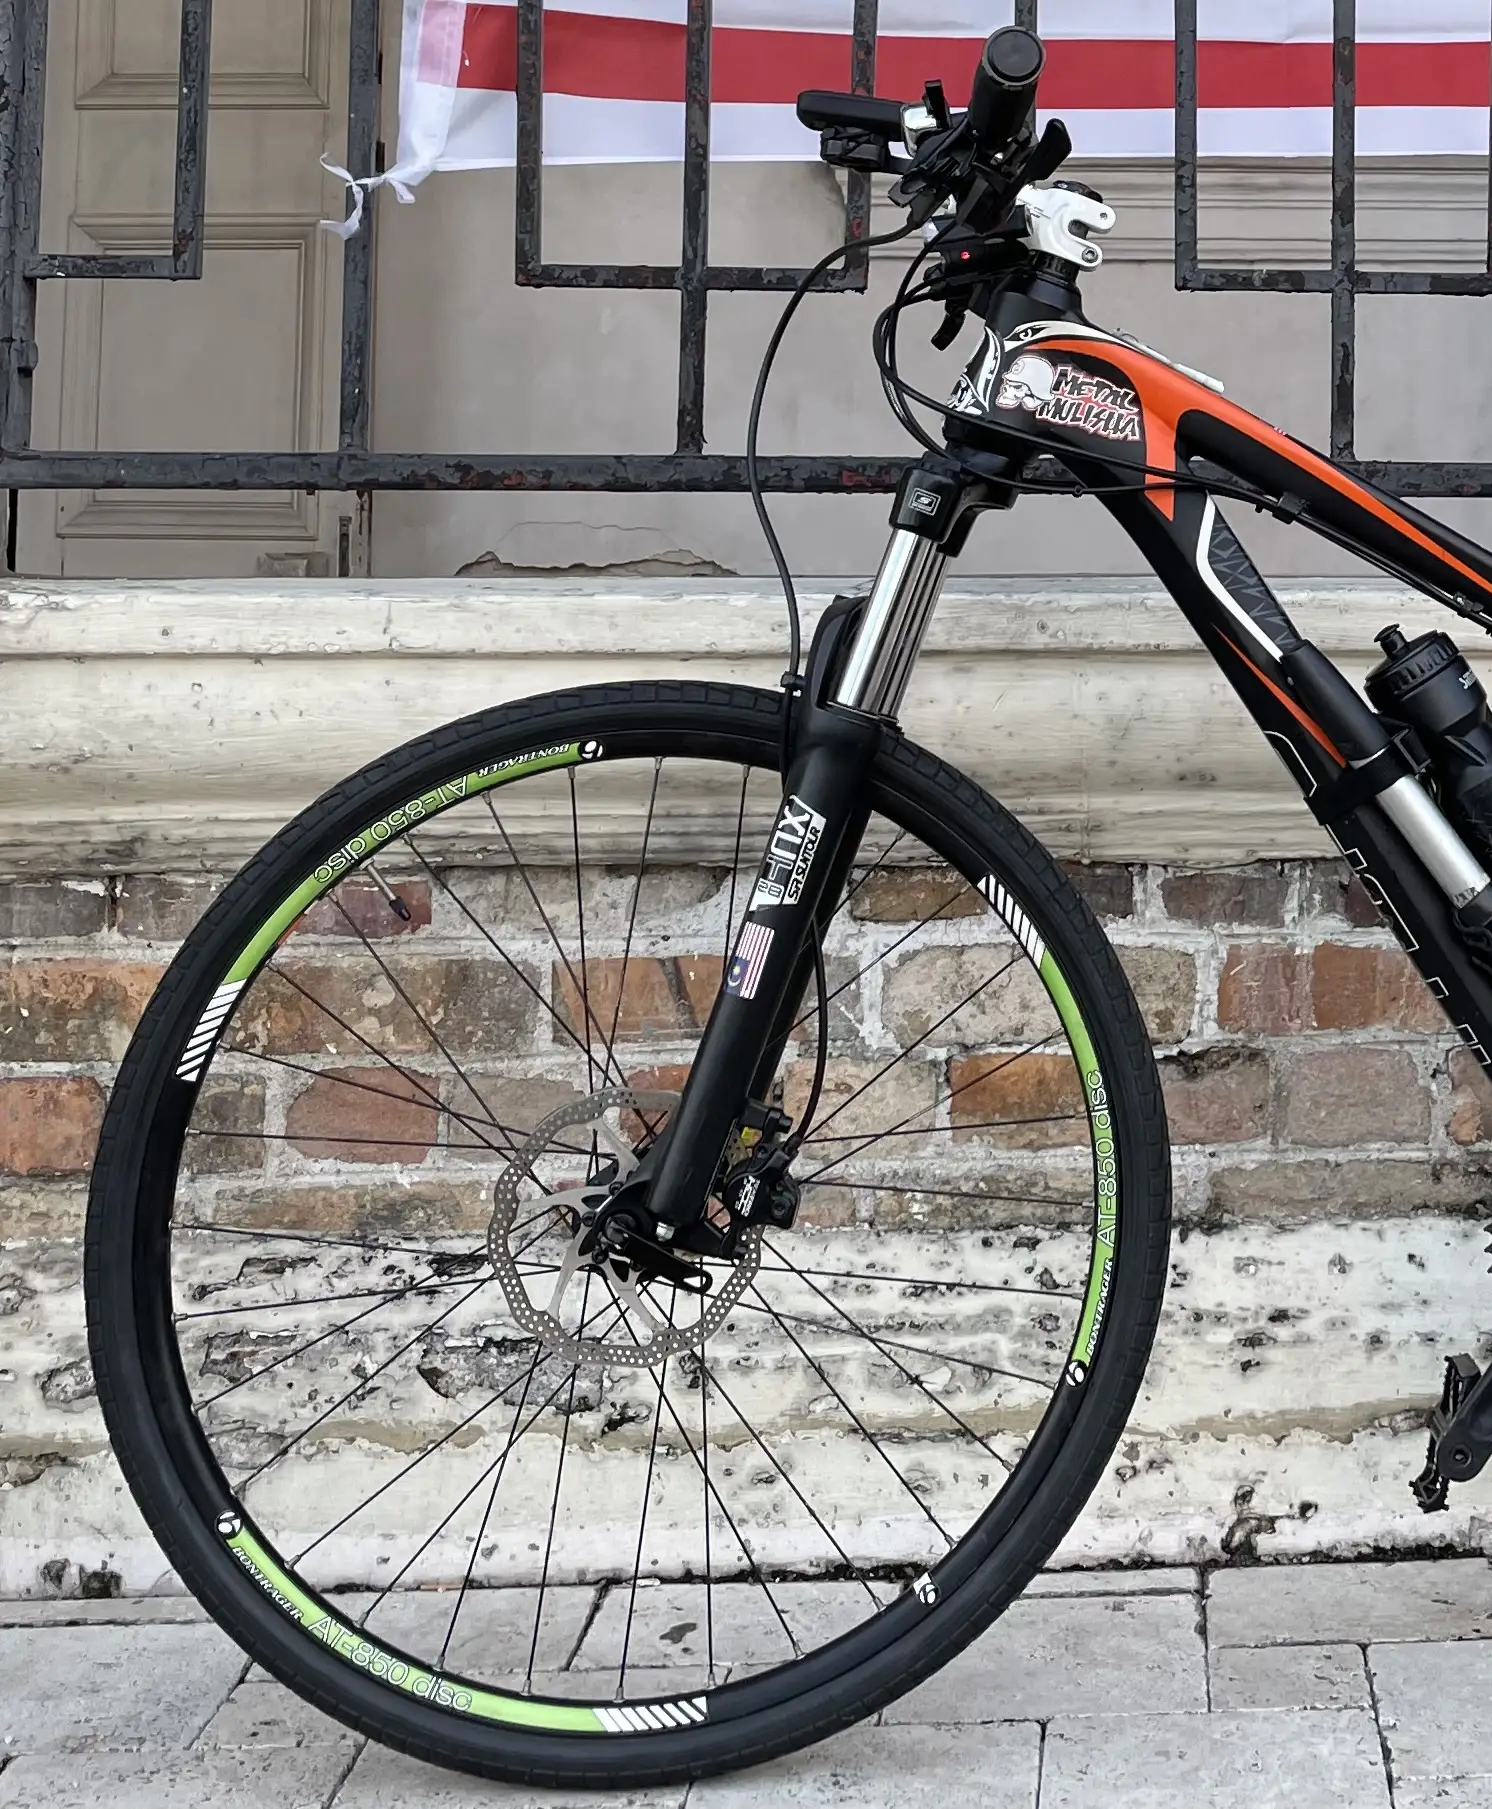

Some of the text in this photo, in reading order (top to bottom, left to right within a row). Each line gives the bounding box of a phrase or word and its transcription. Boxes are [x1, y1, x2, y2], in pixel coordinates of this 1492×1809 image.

[1051, 366, 1140, 413] METAL
[313, 743, 571, 884] BONTRAGER AT-850 disc
[1085, 1069, 1118, 1359] BONTRAGER AT-850 disc
[231, 1546, 473, 1713] BONTRAGER AT-850 disc
